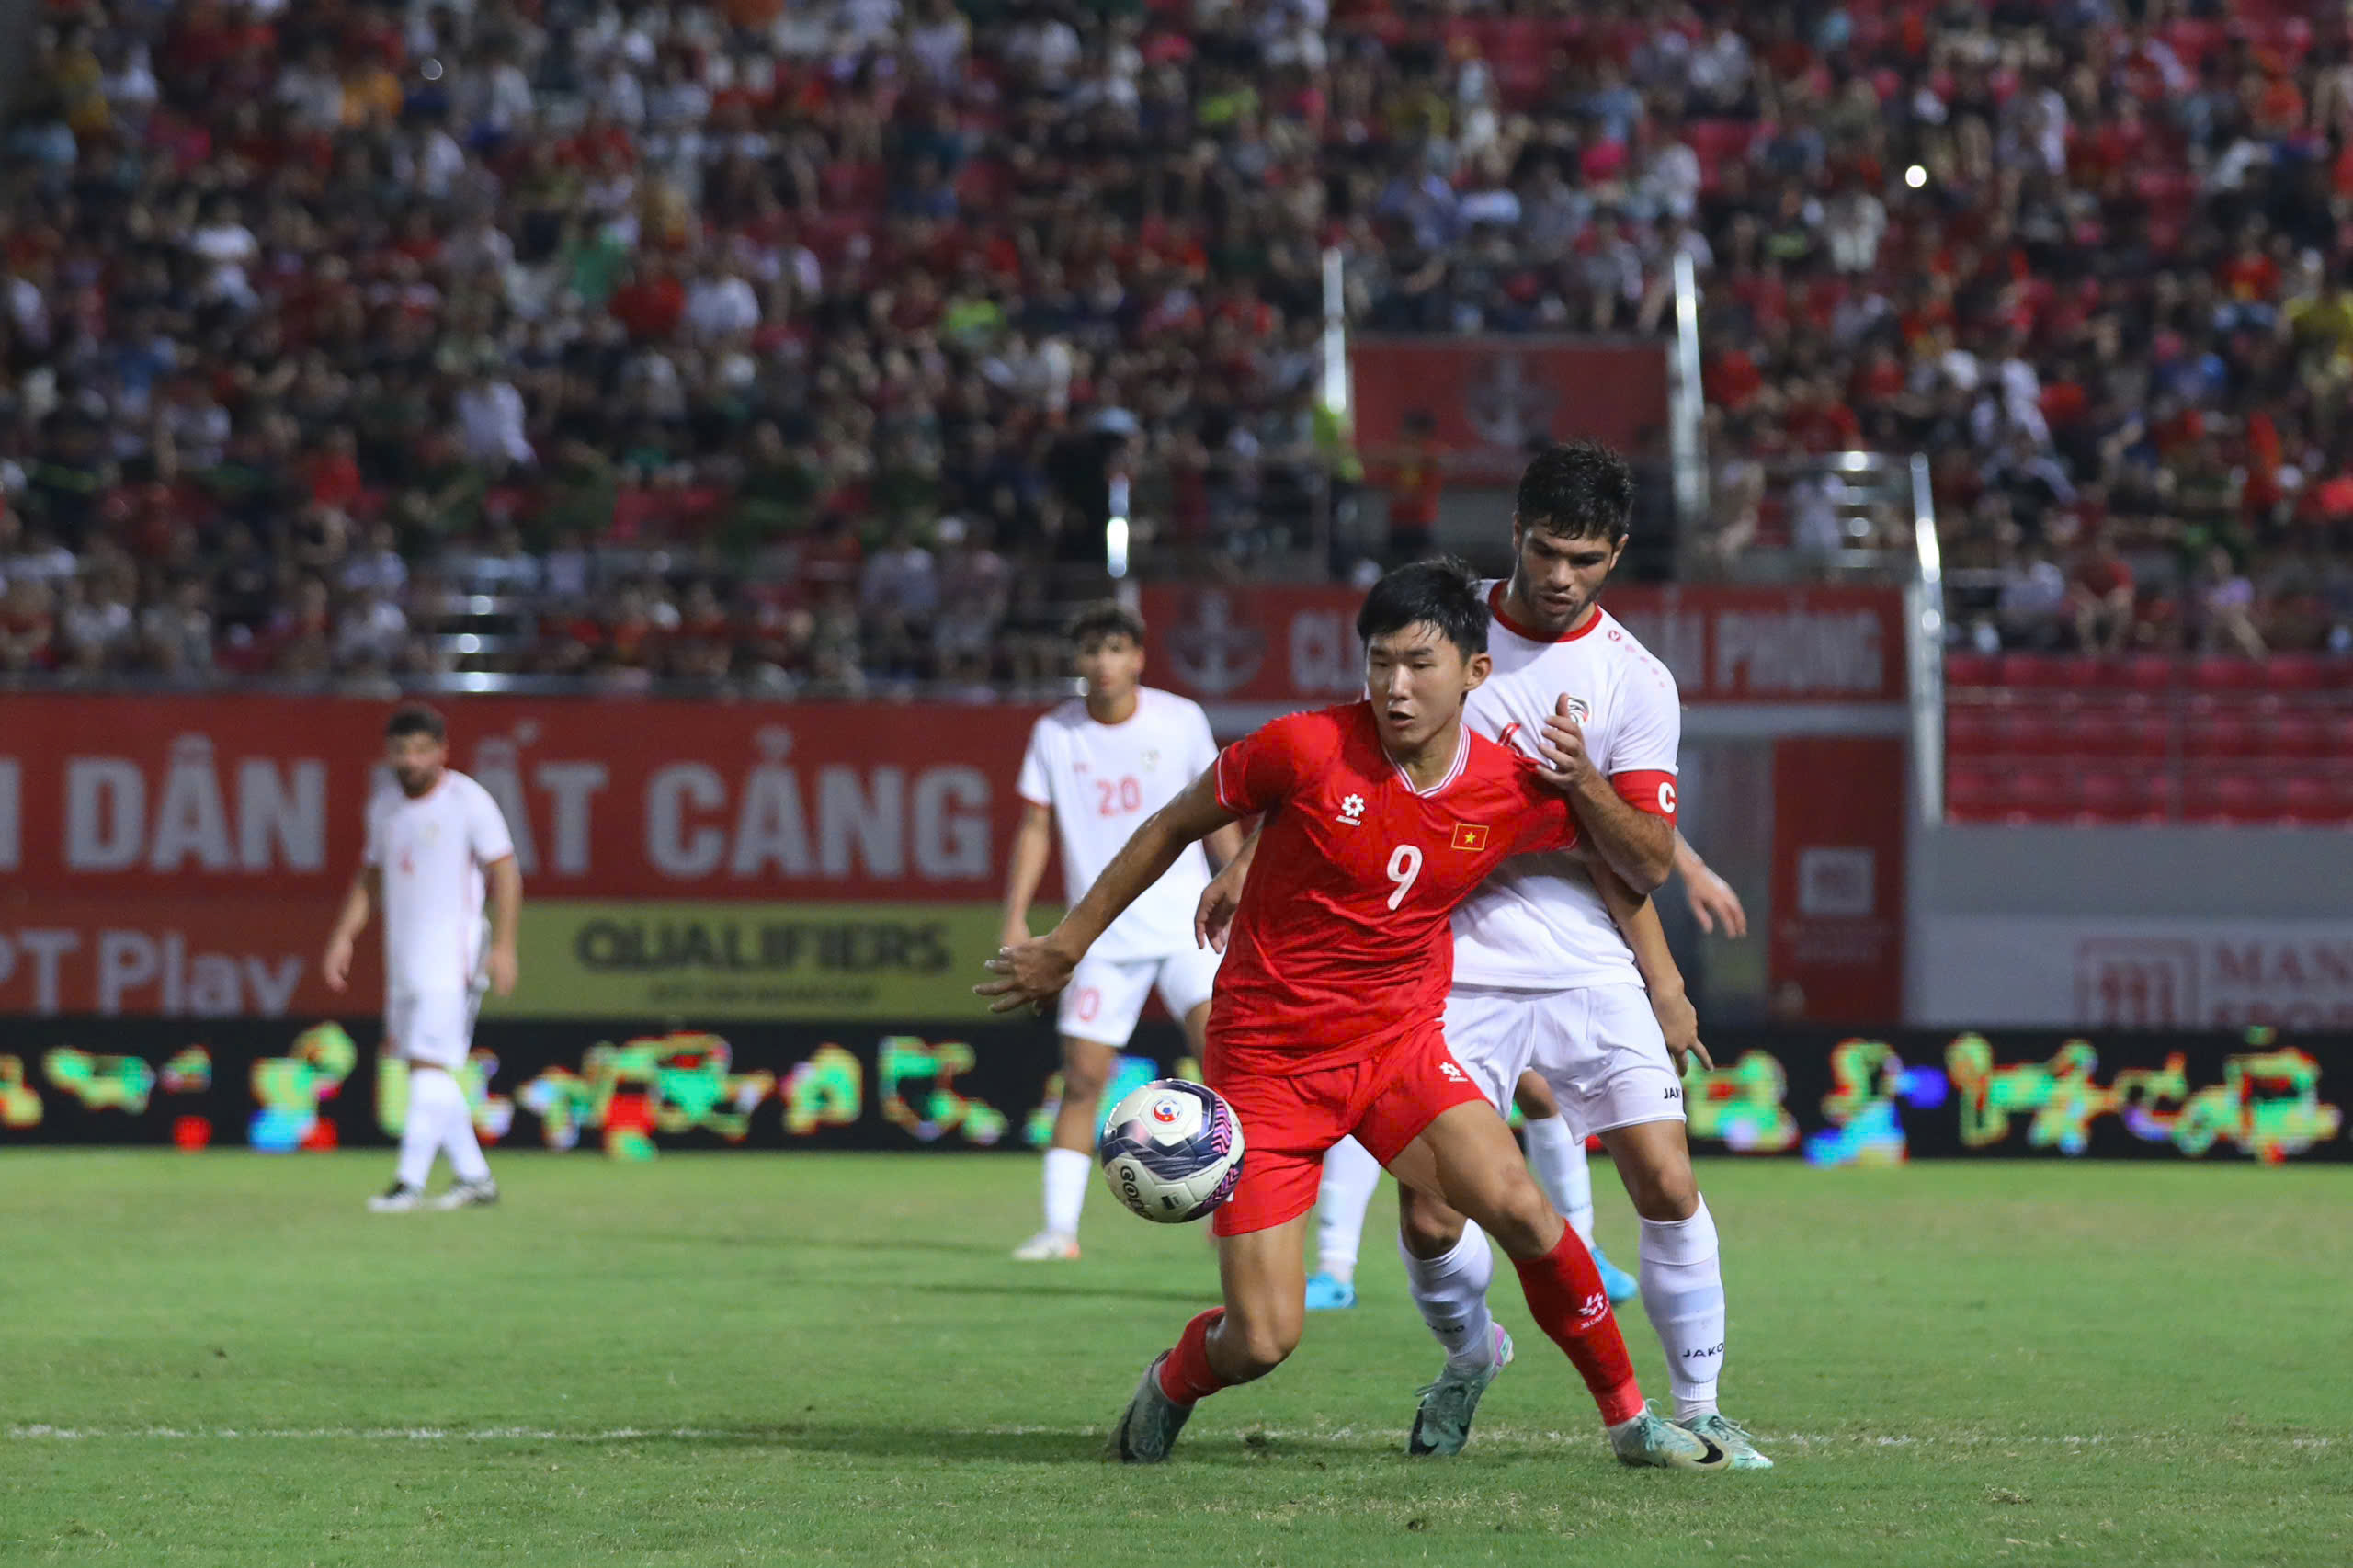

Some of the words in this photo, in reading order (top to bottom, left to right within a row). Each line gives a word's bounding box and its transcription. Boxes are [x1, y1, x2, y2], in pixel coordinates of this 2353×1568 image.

[64, 732, 329, 873] DÂN
[646, 723, 995, 880] CẢNG
[1095, 776, 1143, 820] 20
[1657, 781, 1677, 814] C
[1385, 843, 1424, 911] 9
[1682, 1342, 1725, 1358] JAKO
